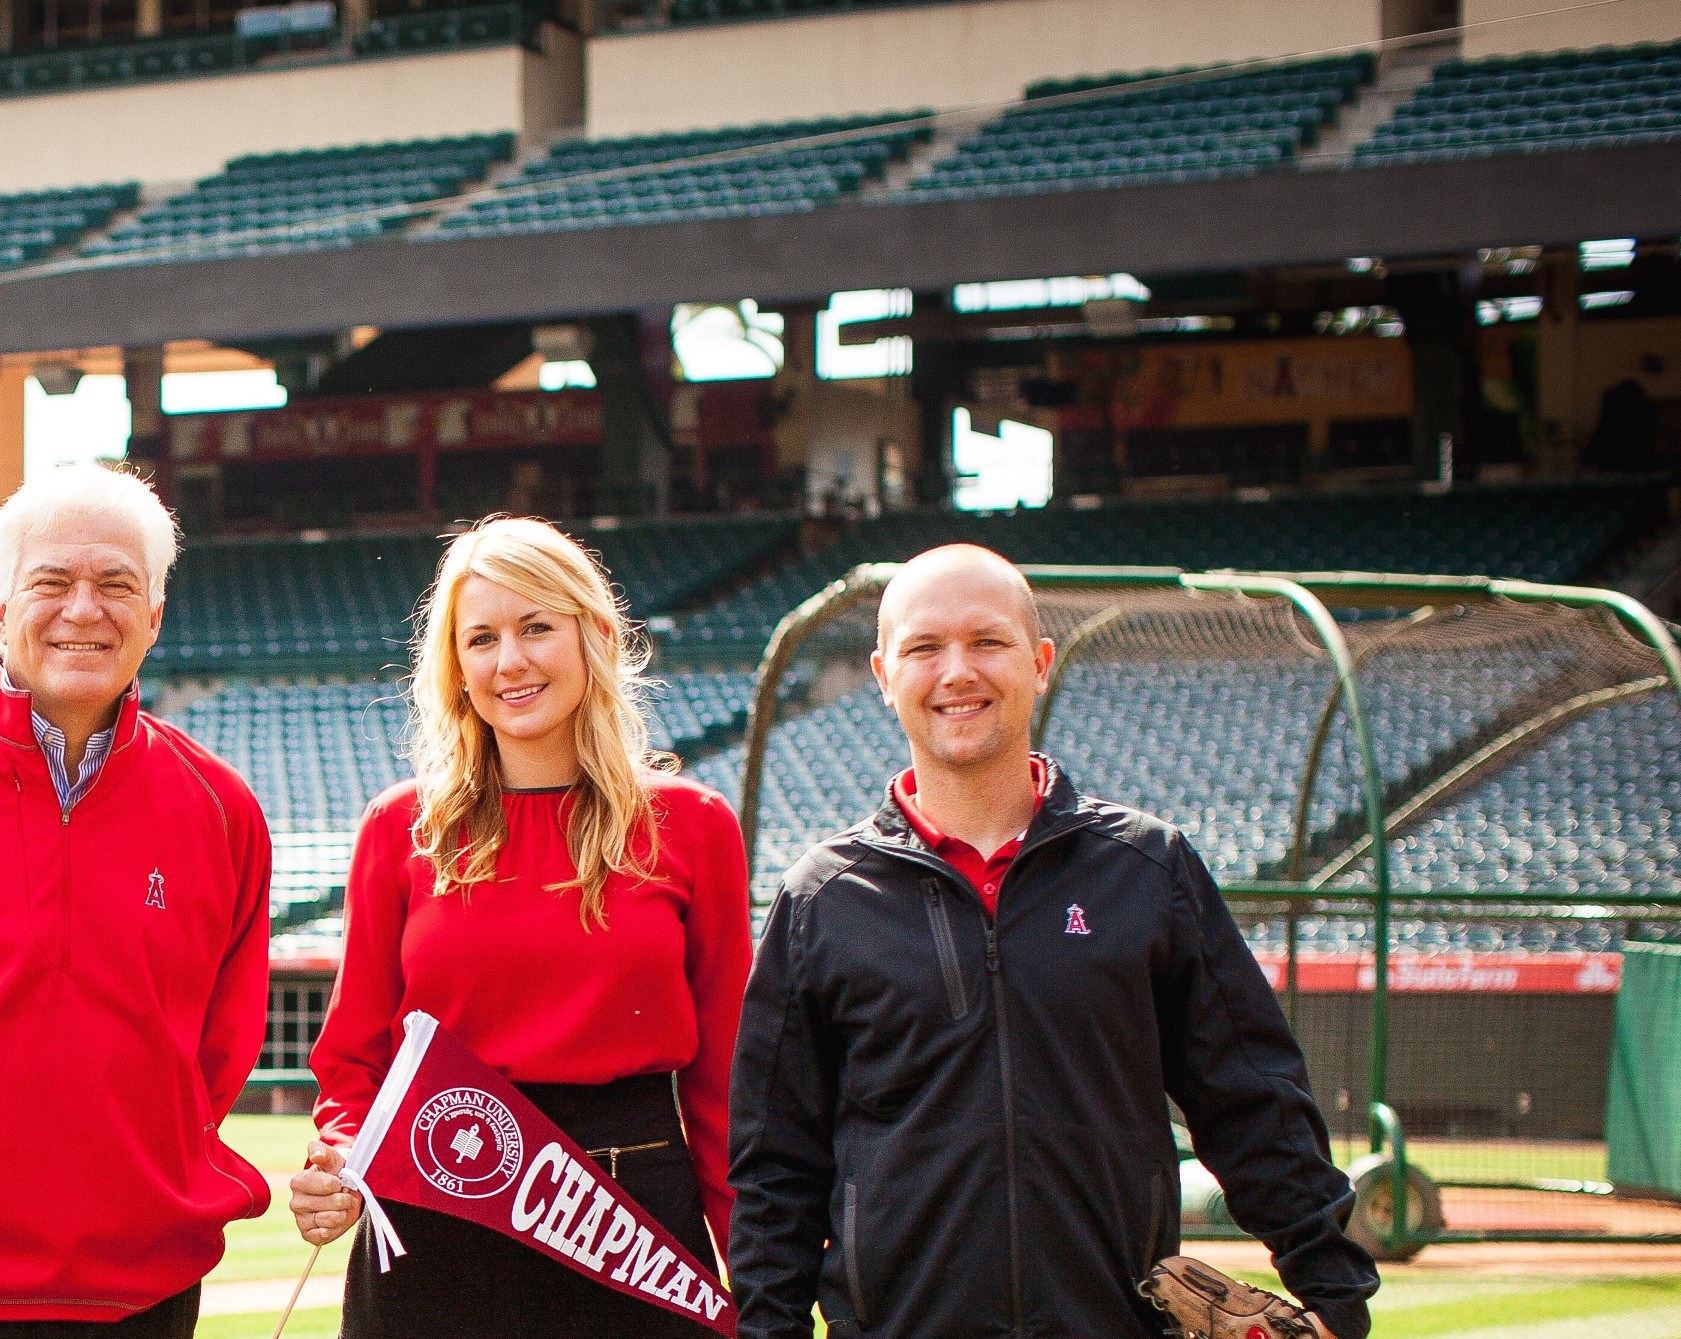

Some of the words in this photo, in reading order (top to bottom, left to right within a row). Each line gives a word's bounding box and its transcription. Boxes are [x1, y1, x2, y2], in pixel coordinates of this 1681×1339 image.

[418, 1091, 485, 1131] CHAPMAN
[486, 1100, 520, 1179] UNIVERSITY
[430, 1168, 463, 1193] 1861
[512, 1142, 727, 1320] CHAPMAN
